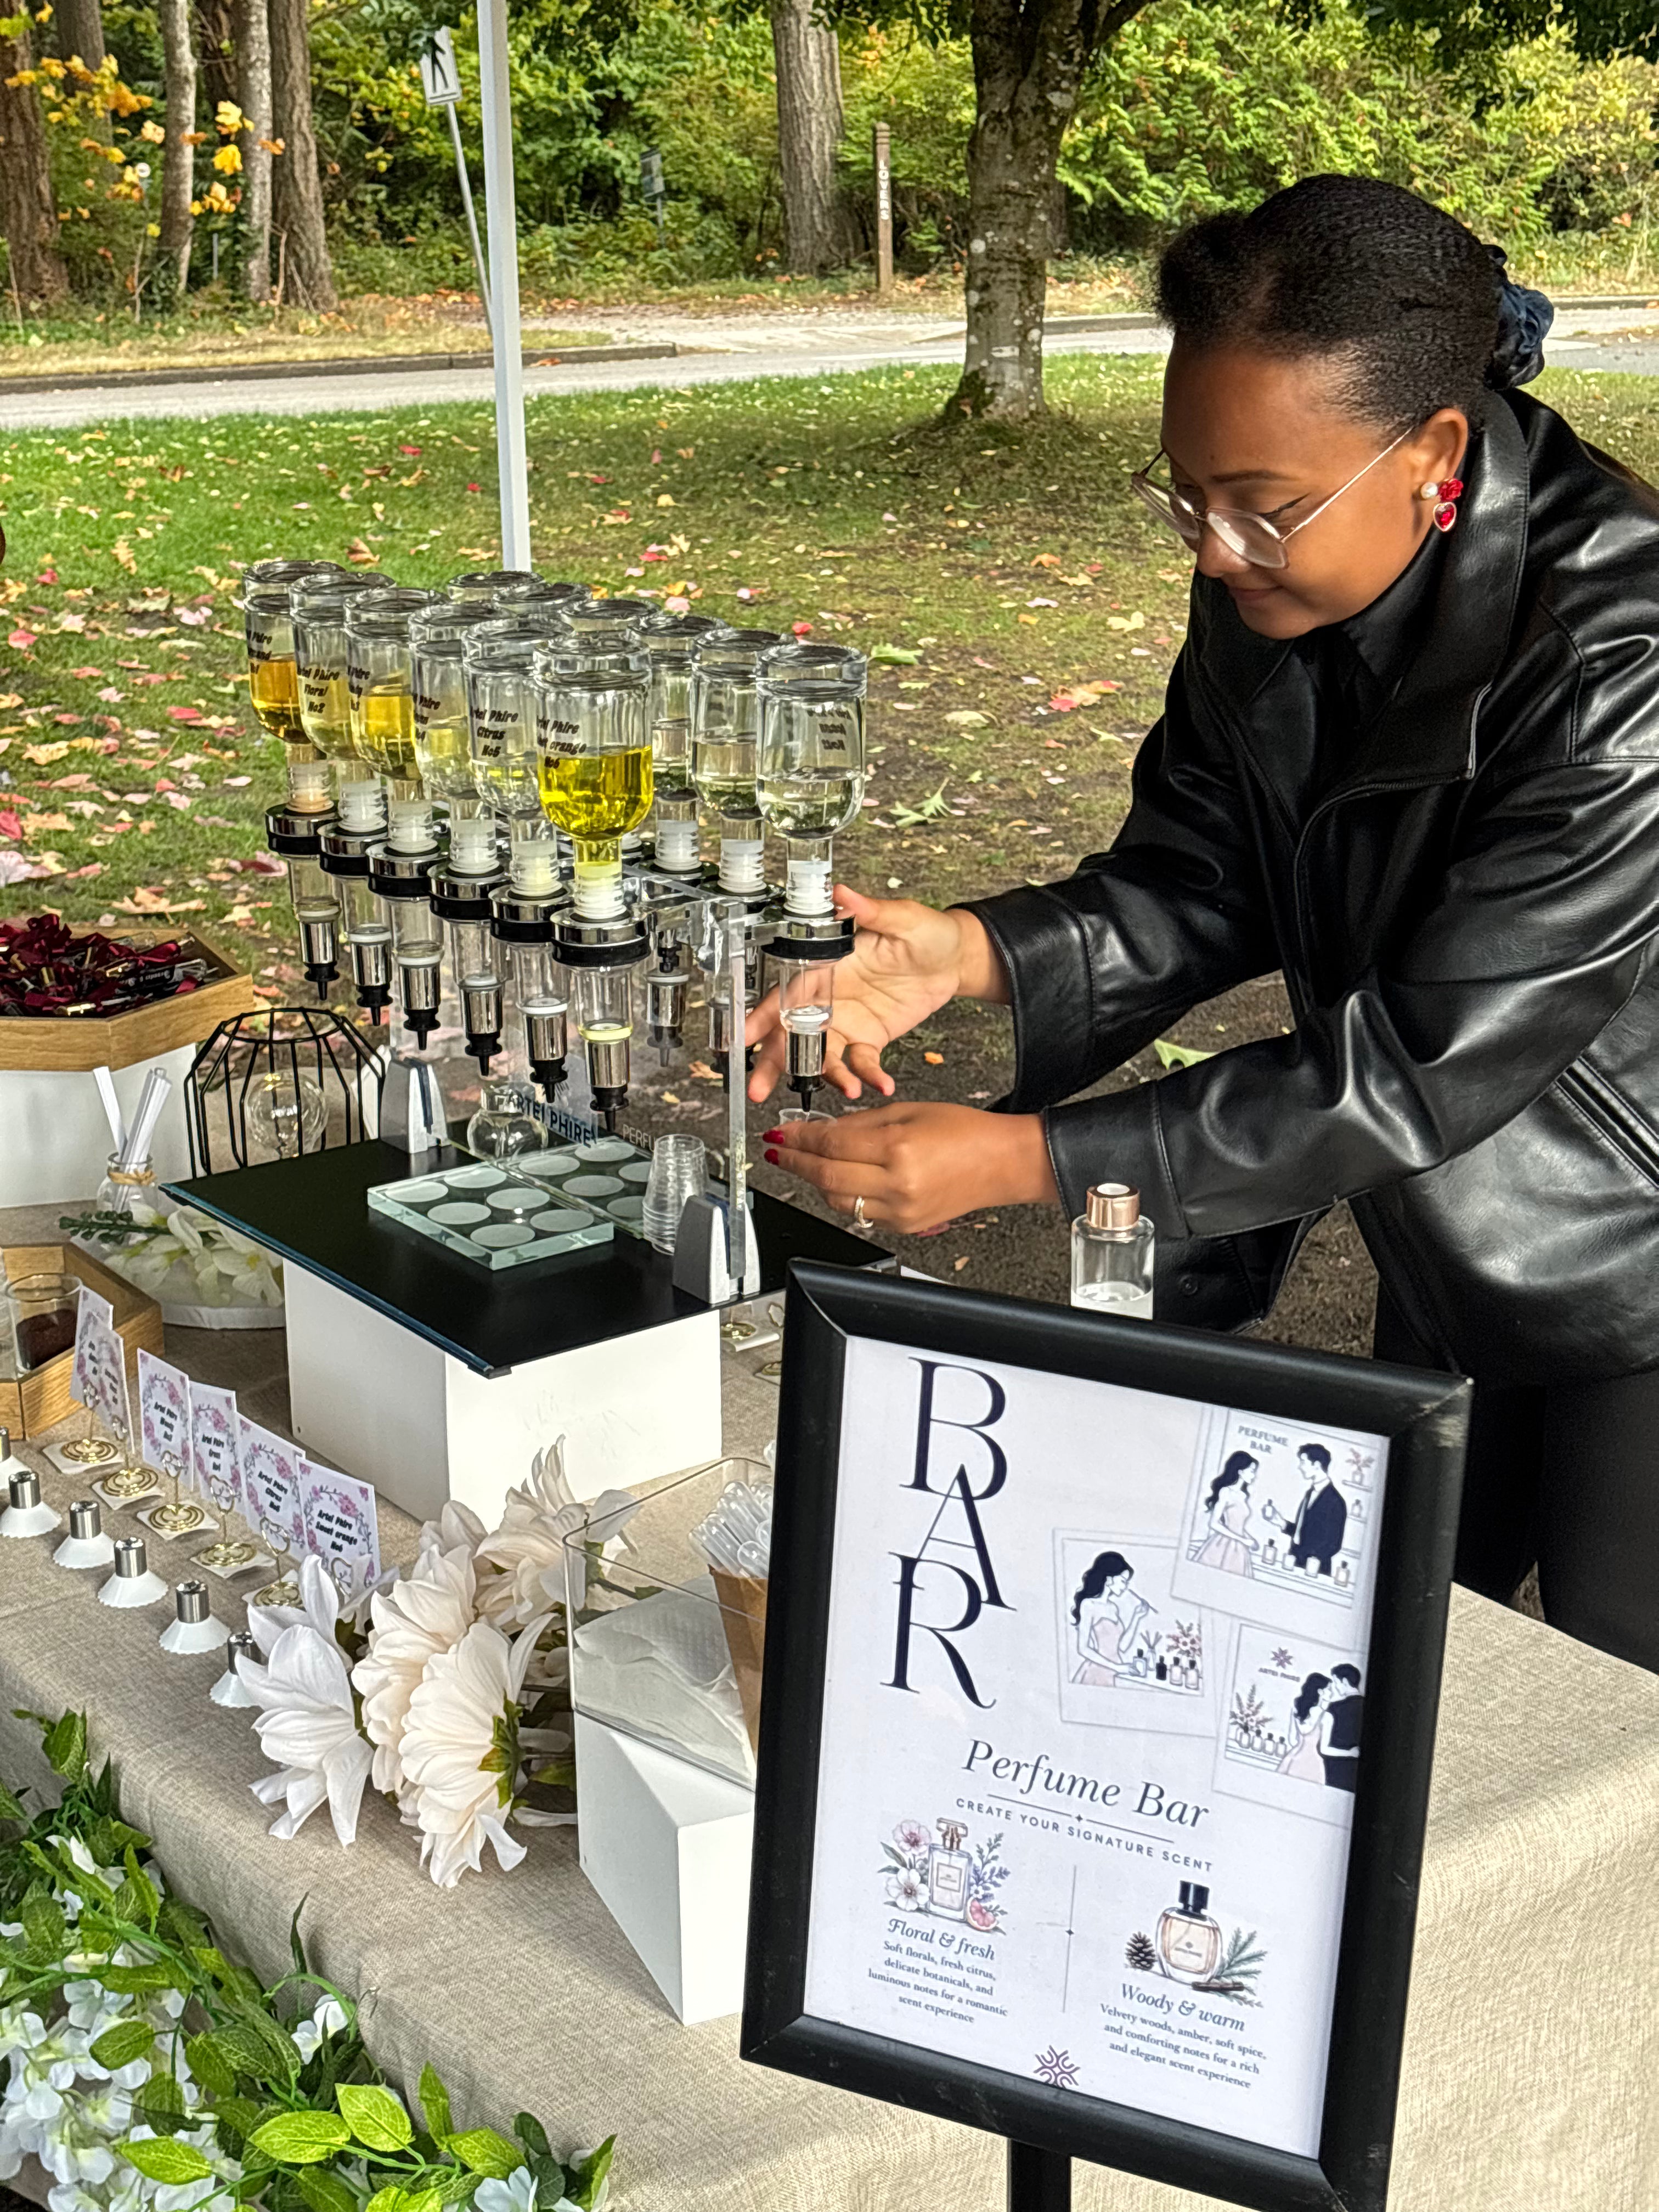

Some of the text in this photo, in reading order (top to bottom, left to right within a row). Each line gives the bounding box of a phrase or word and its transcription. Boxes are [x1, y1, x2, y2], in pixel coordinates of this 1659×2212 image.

[878, 159, 889, 221] LOVERS
[304, 684, 329, 697] Floral
[313, 668, 340, 681] Phire
[308, 701, 325, 714] No2
[488, 710, 519, 723] Phire
[477, 726, 506, 740] Citrus
[550, 720, 580, 734] Phire
[481, 744, 501, 758] No5
[550, 741, 587, 755] orange
[550, 1109, 591, 1148] PHIRE
[1238, 1425, 1288, 1446] PERFUME
[1250, 1440, 1272, 1453] BAR
[315, 1521, 358, 1545] Sweet orange
[335, 1516, 353, 1531] Phire
[880, 1356, 1017, 1709] BAR
[961, 1739, 1209, 1828] Perfume Bar
[956, 1798, 1213, 1872] CREATE YOUR SIGNATURE SCENT
[887, 1918, 995, 1960] Floral & fresh
[884, 1940, 996, 1980] Soft florals, fresh citrus,
[884, 1957, 994, 1995] delicate botanicals, and
[868, 1968, 911, 1988] luminous
[913, 1983, 938, 1996] notes
[941, 1990, 955, 2000] for
[966, 1999, 1008, 2016] romantic
[1121, 1983, 1245, 2032] Woody & warm
[899, 1996, 974, 2023] scent experience
[1100, 2003, 1137, 2024] Velvety
[1140, 2016, 1175, 2034] woods,
[1178, 2028, 1212, 2045] amber,
[1215, 2038, 1234, 2050] soft
[1104, 2023, 1122, 2035] and
[1125, 2030, 1181, 2054] comforting
[1183, 2047, 1210, 2060] notes
[1213, 2053, 1228, 2065] for
[1239, 2062, 1260, 2074] rich
[1109, 2042, 1251, 2089] and elegant scent experience
